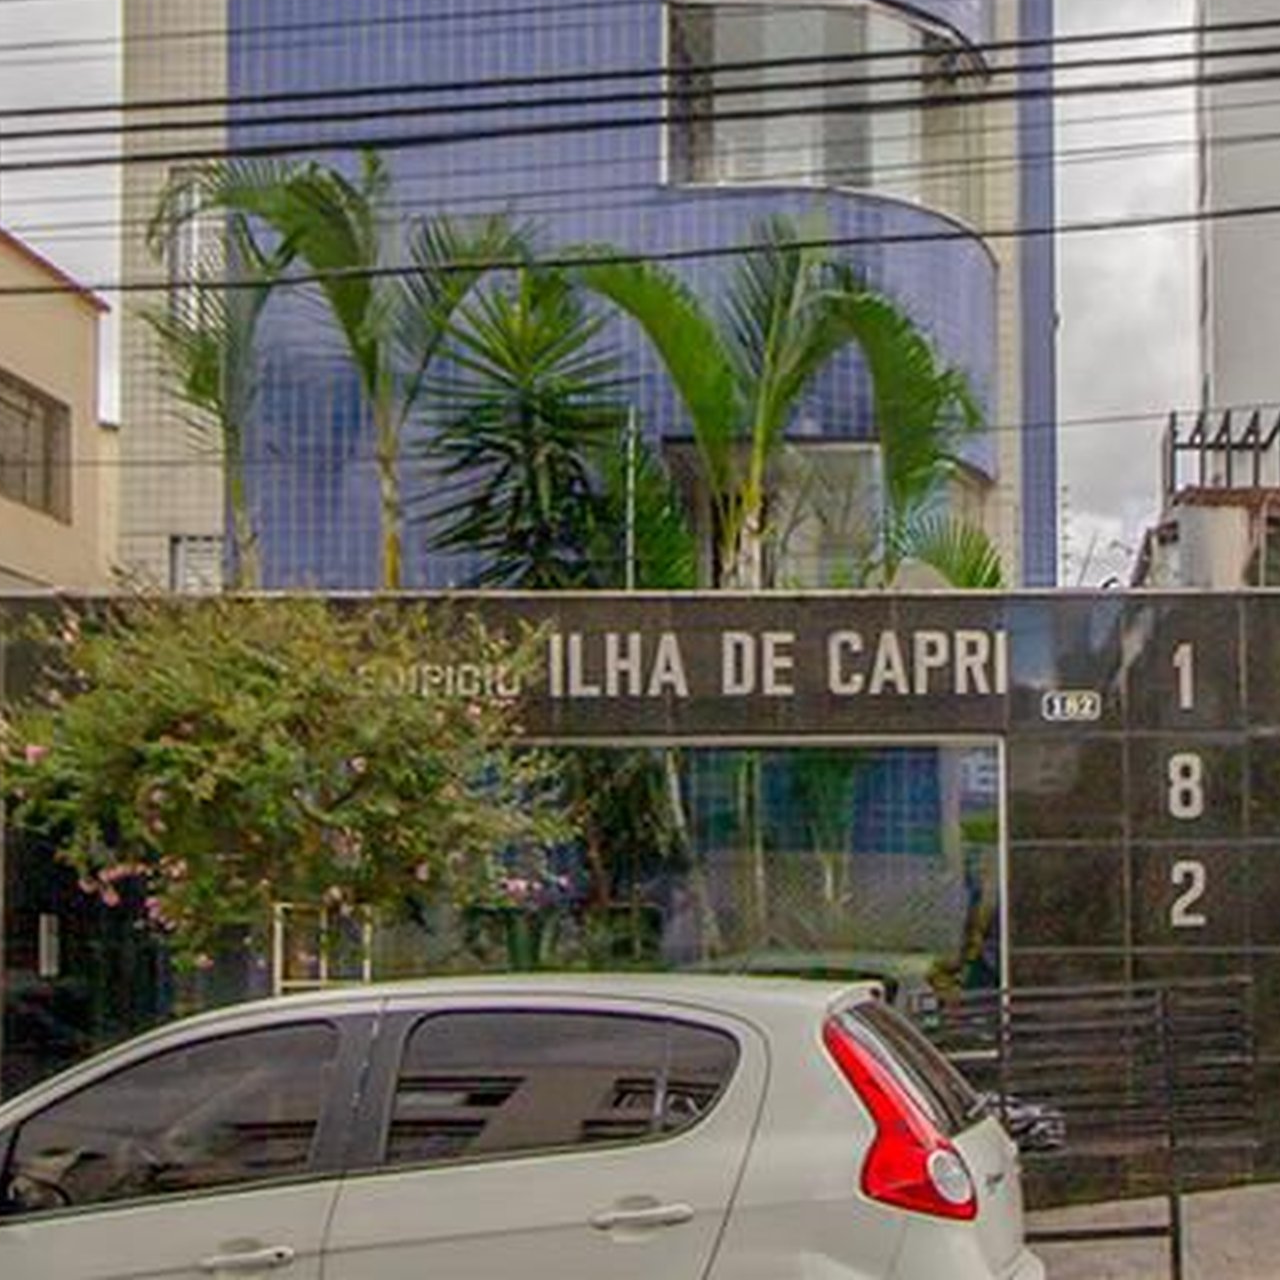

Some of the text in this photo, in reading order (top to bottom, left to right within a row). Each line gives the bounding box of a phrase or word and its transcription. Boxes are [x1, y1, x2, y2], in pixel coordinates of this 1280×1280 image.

[548, 631, 689, 697] ILHA
[722, 630, 796, 696] DE
[827, 629, 1008, 695] CAPRI
[1050, 694, 1098, 716] 182
